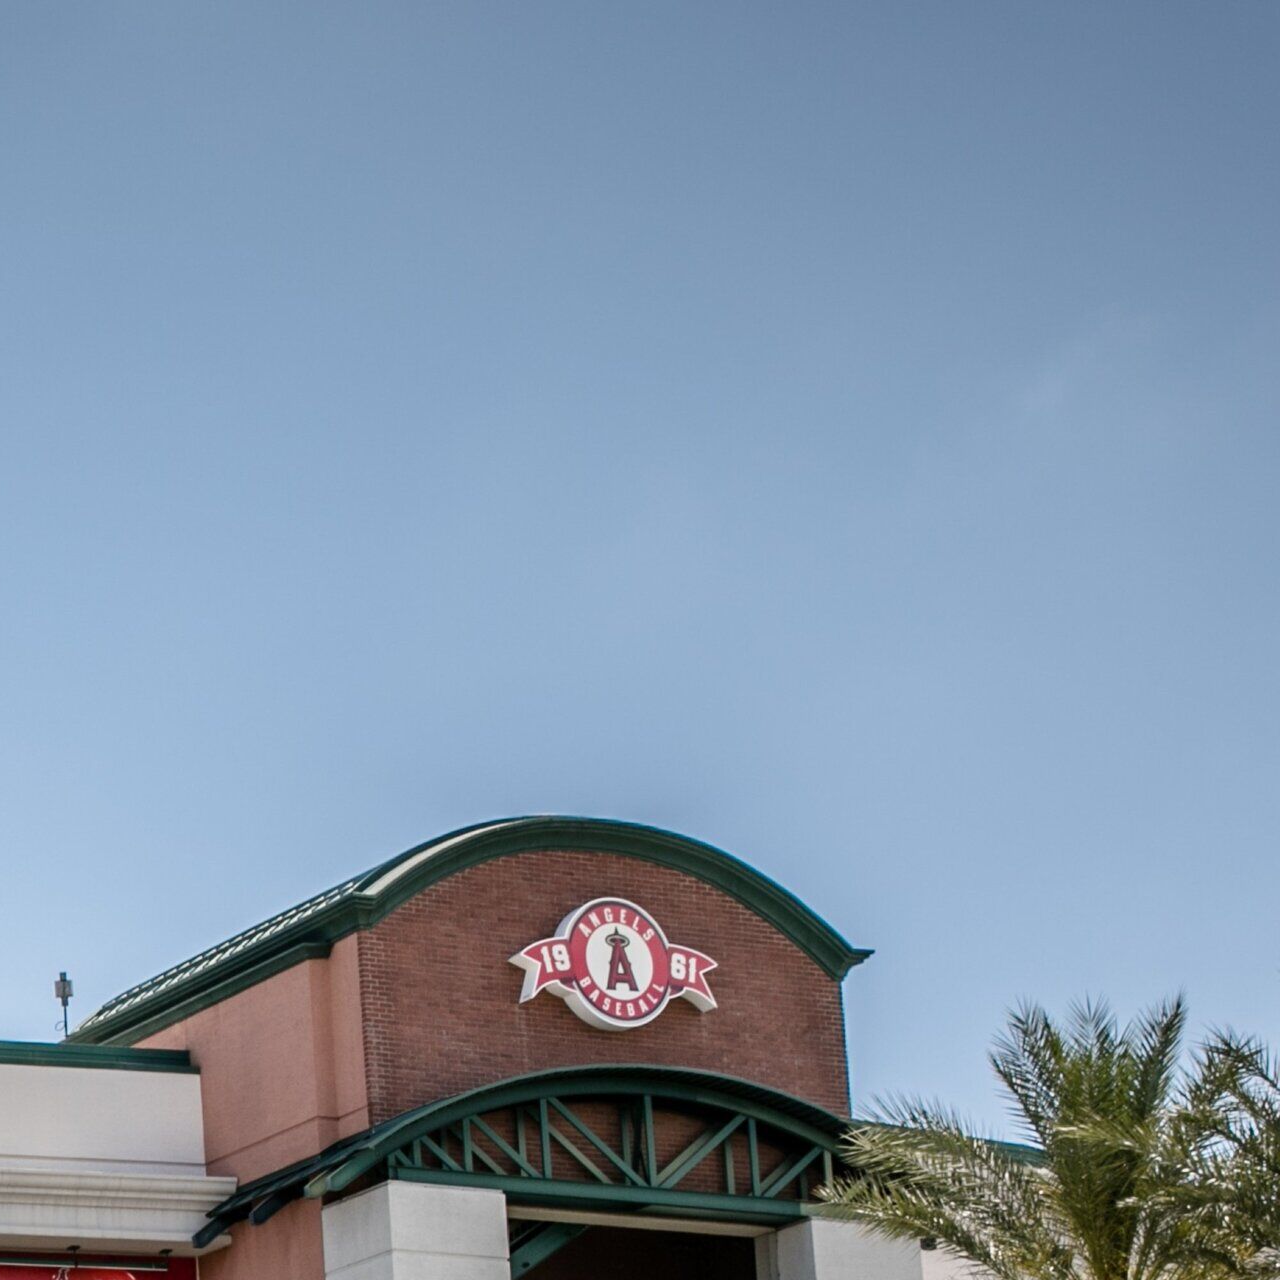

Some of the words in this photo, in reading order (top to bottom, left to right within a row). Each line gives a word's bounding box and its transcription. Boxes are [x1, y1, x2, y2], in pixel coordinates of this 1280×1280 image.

[578, 907, 653, 939] ANGELS
[540, 944, 572, 973] 19
[670, 952, 698, 984] 61
[579, 976, 665, 1017] BASEBALL
